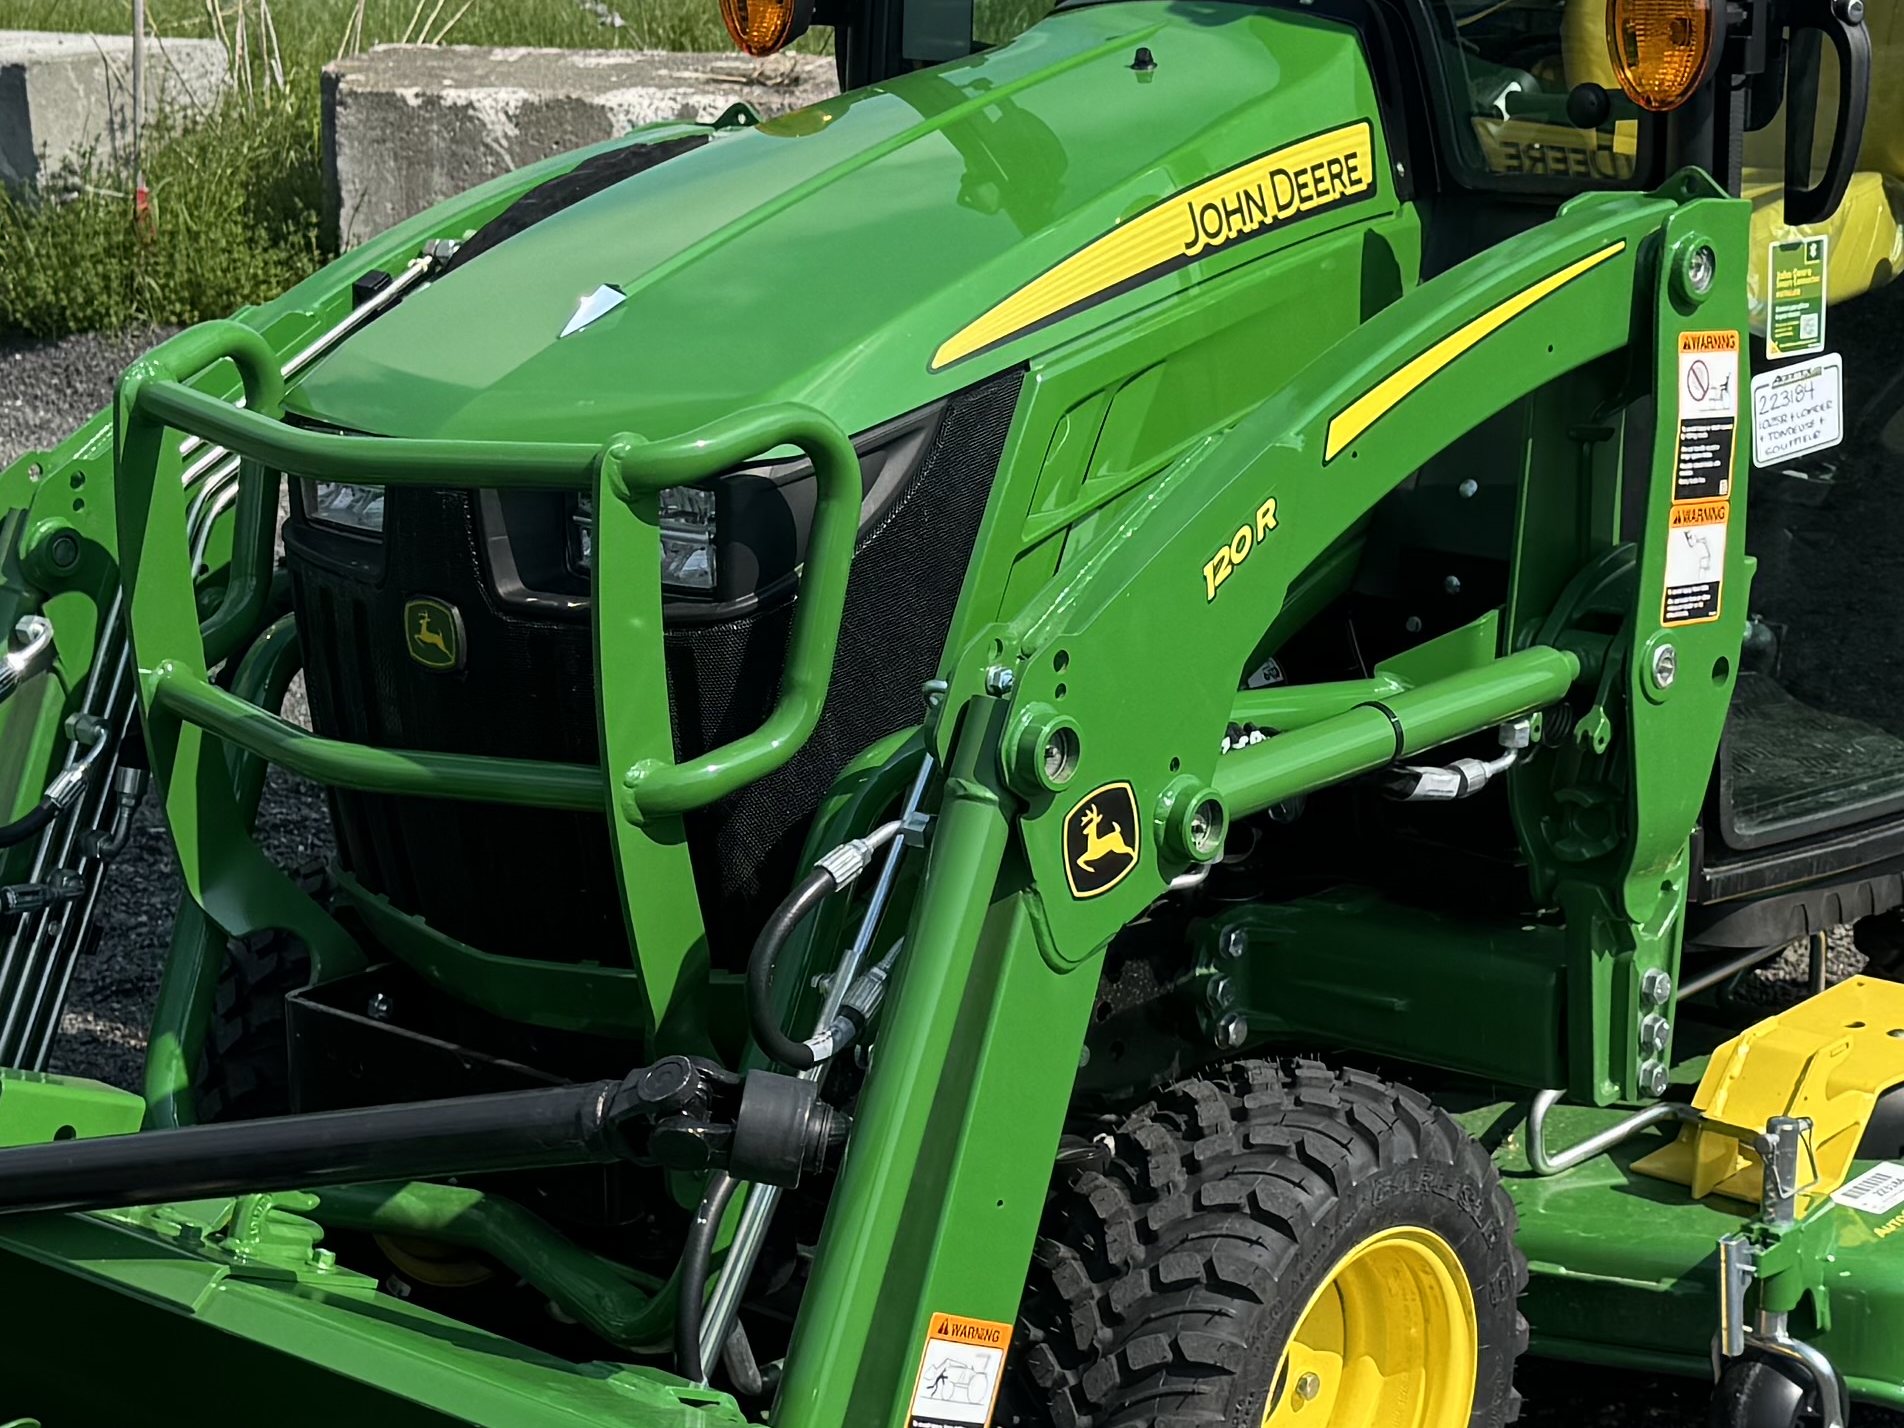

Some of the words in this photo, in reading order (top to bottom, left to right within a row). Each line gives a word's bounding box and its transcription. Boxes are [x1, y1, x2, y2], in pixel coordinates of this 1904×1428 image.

[1184, 183, 1269, 252] JOHN
[1269, 151, 1363, 213] DEERE
[1691, 334, 1736, 350] WARNING
[1759, 381, 1815, 415] 223184
[1683, 506, 1726, 524] WARNING
[951, 1323, 1001, 1344] WARNING
